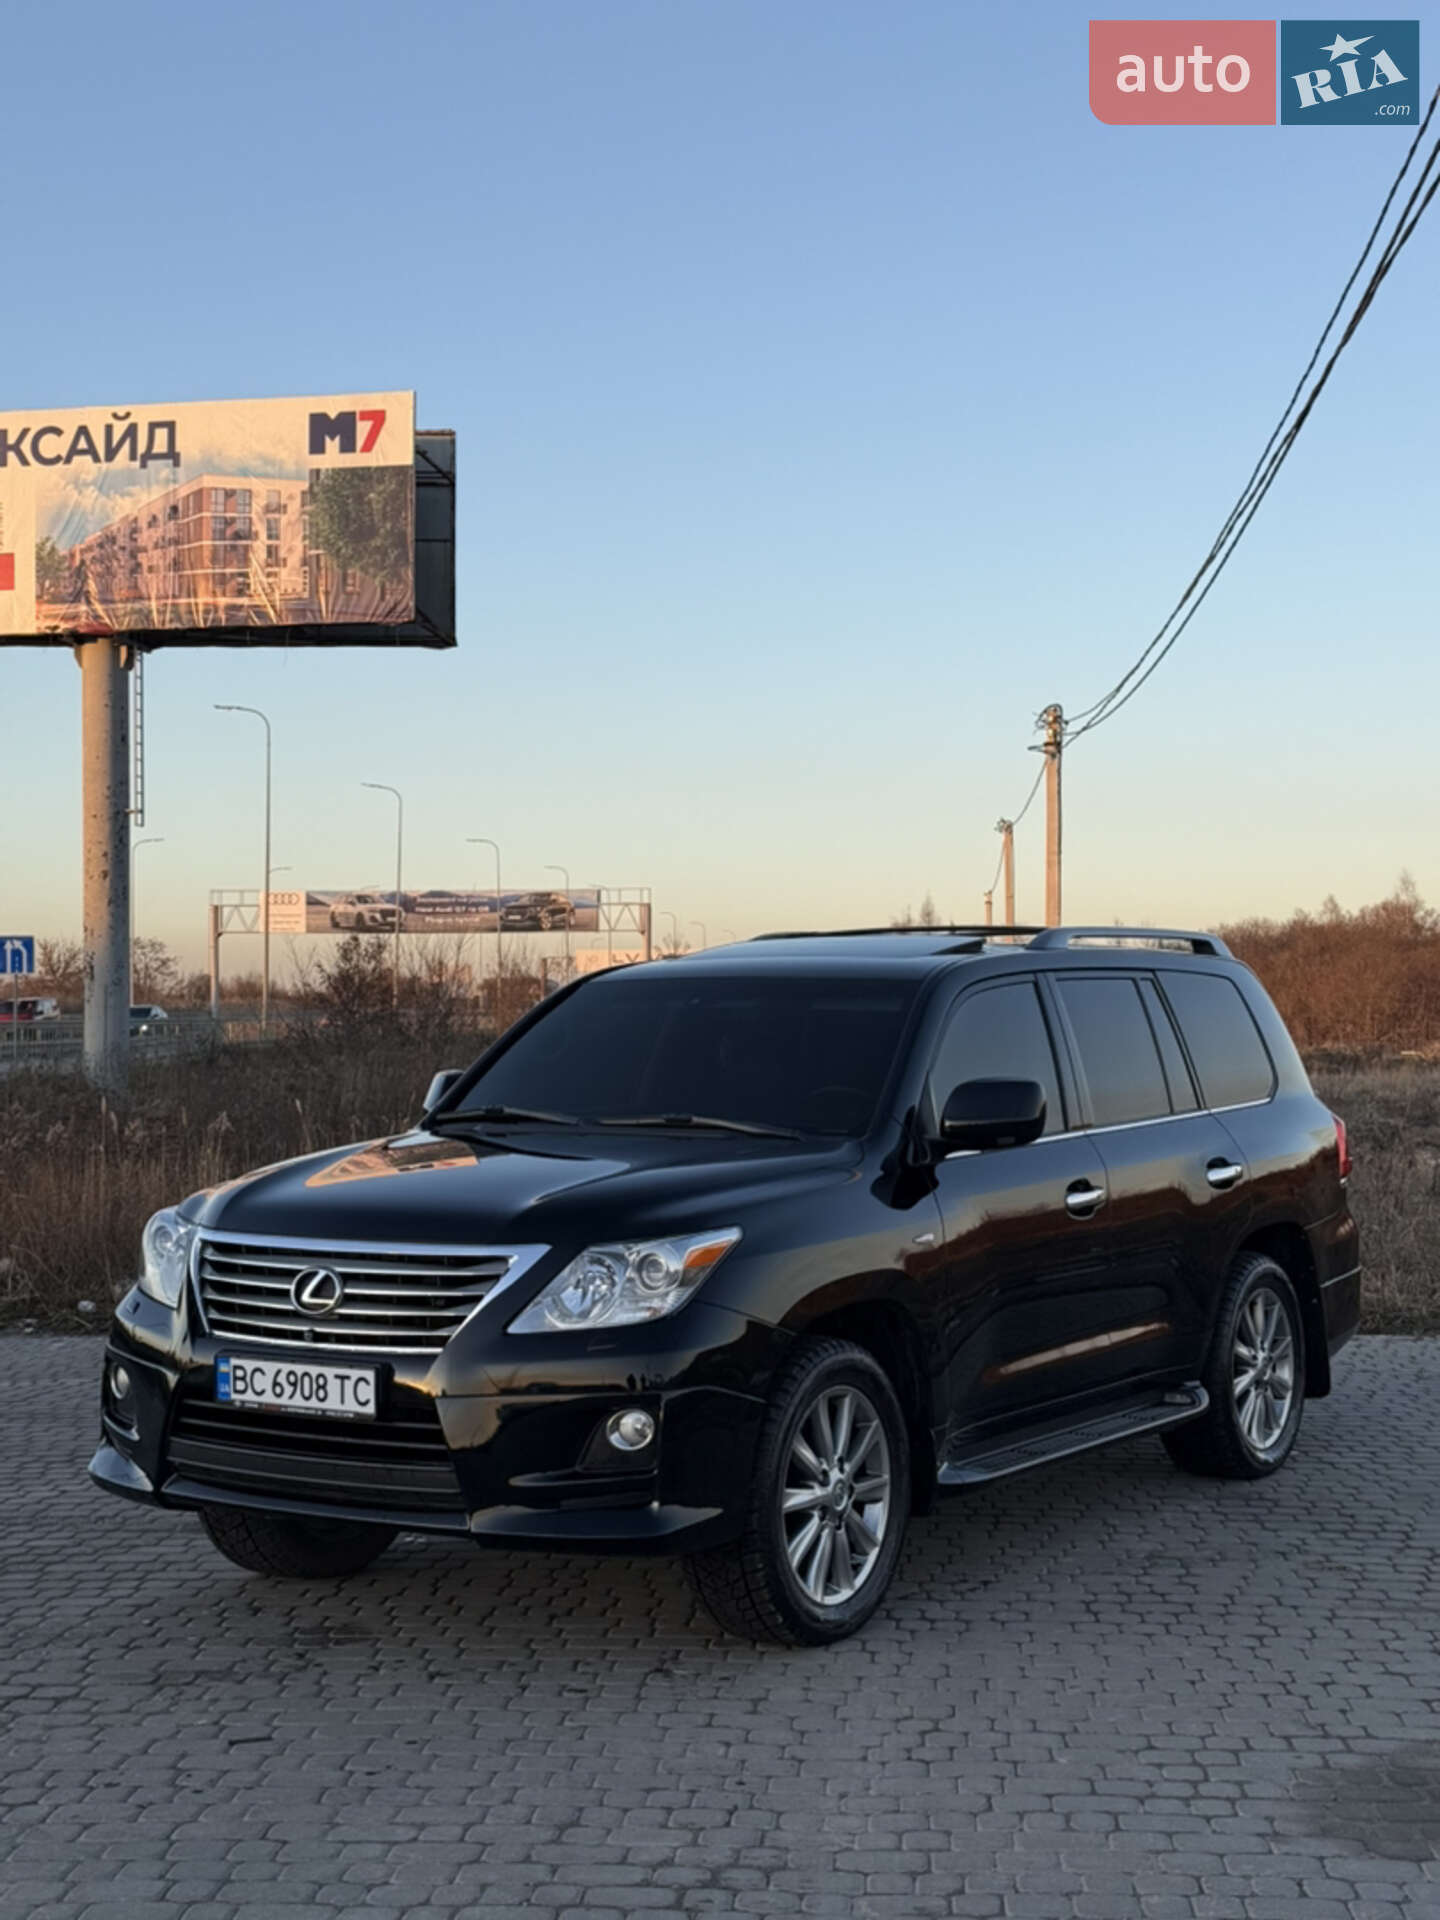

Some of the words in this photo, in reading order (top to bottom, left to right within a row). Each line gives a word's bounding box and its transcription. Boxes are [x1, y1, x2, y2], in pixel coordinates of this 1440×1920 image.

[0, 411, 181, 469] КСАЙД
[309, 409, 387, 455] M7
[232, 1365, 267, 1397] BC
[271, 1368, 329, 1402] 6908
[333, 1374, 371, 1406] TC
